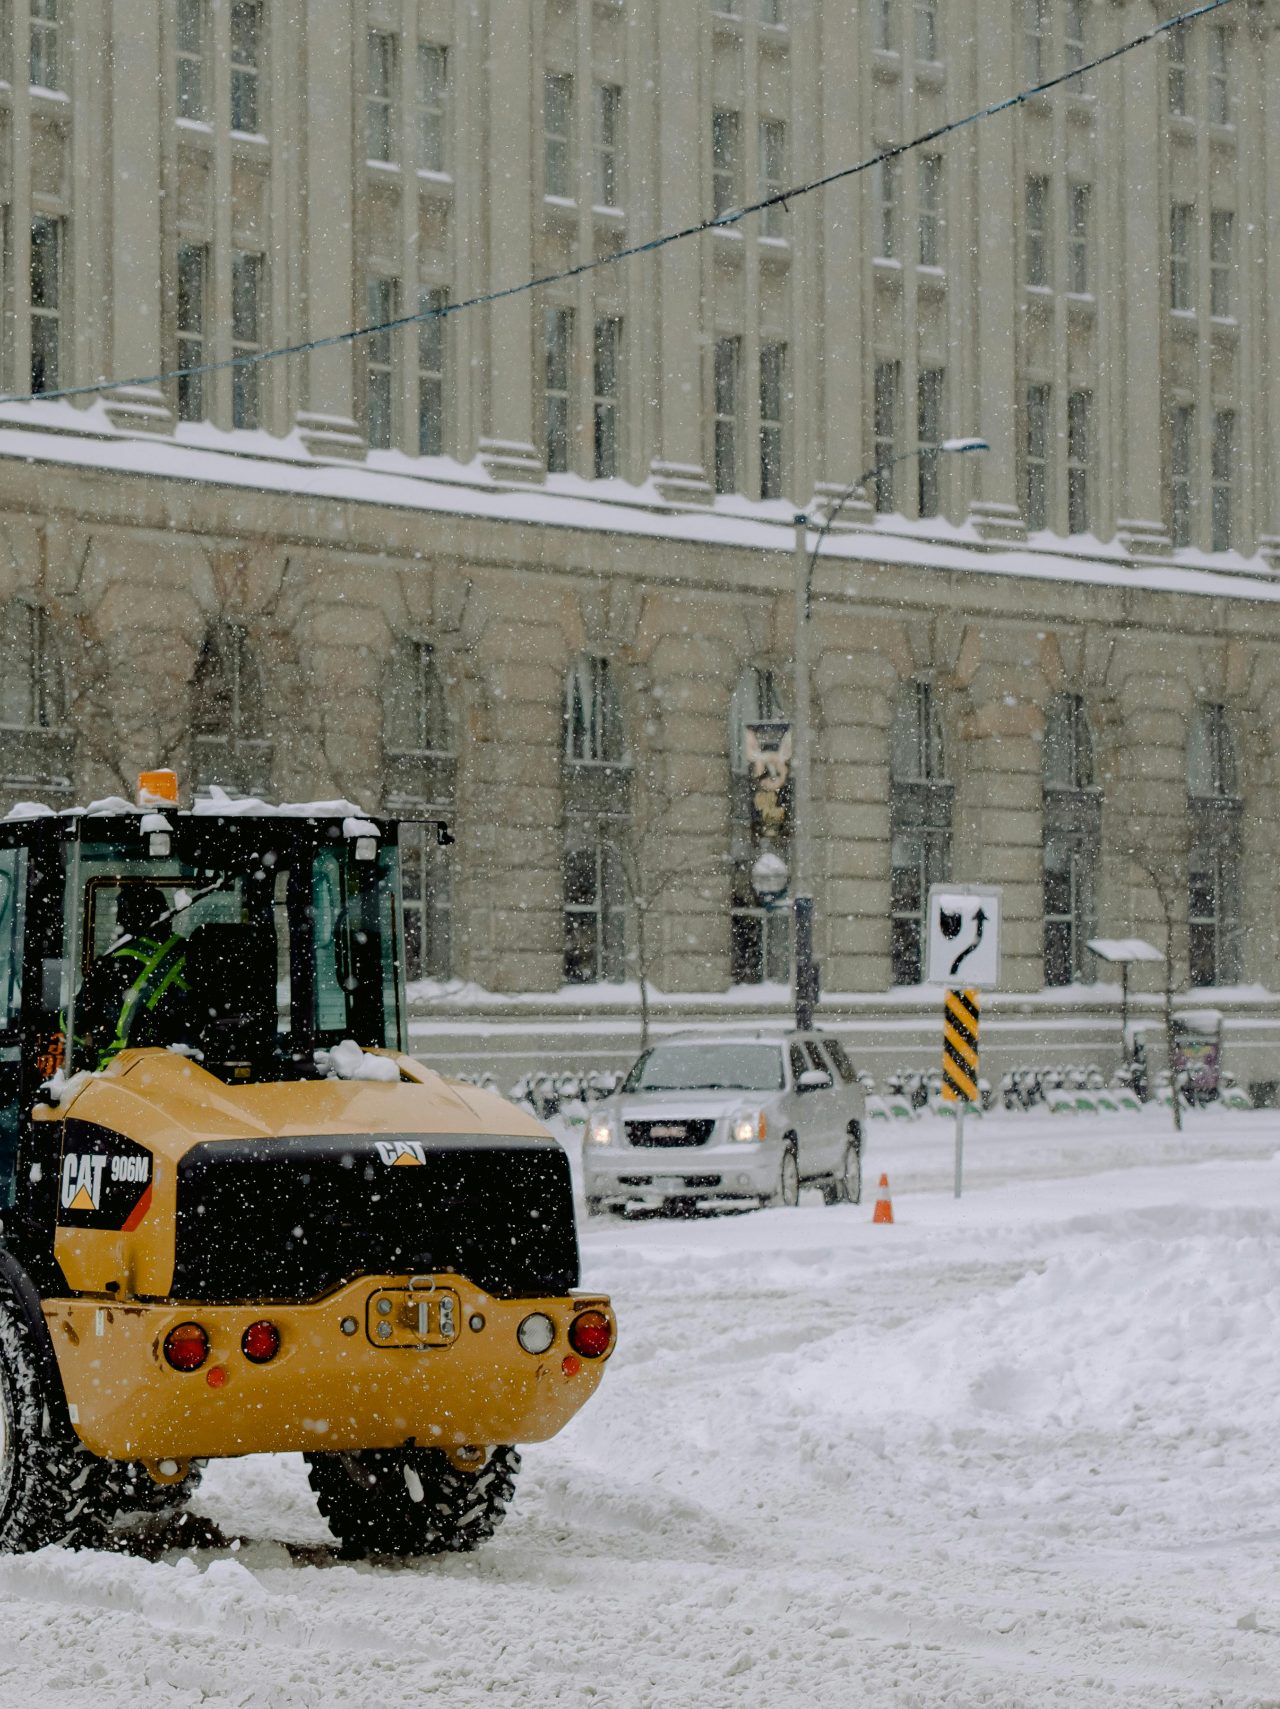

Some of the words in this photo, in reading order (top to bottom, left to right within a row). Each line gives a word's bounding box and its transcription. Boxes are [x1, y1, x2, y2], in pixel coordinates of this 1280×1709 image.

[374, 1141, 427, 1166] CAT
[61, 1153, 108, 1210] CAT
[111, 1155, 149, 1182] 906M
